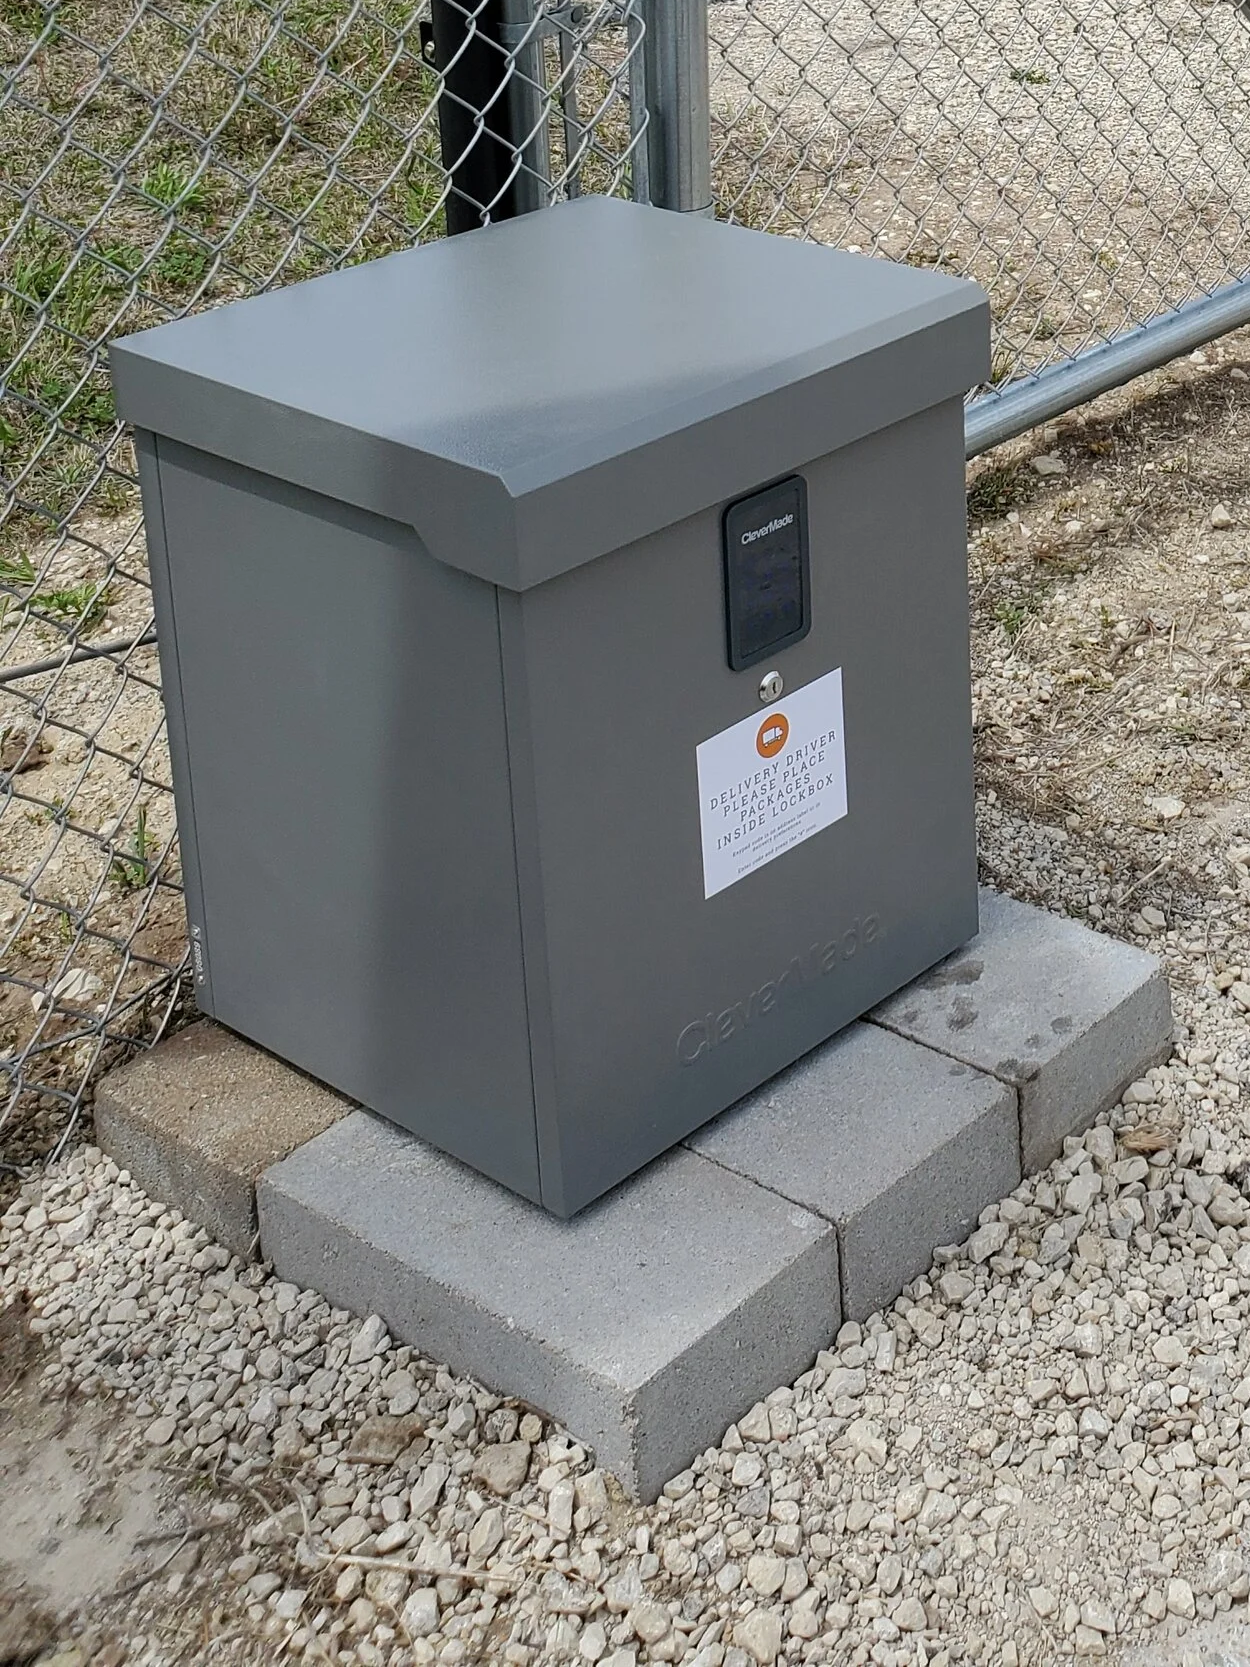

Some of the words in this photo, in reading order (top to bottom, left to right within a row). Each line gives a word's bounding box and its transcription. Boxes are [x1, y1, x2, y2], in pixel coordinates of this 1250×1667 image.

[741, 513, 794, 545] CleverMade
[710, 762, 779, 810] DELIVERY
[786, 730, 836, 767] DRIVER
[723, 778, 776, 818] PLEASE
[783, 750, 825, 782] PLACE
[740, 773, 811, 822] PACKAGES
[717, 813, 766, 850] INSIDE
[772, 773, 834, 818] LOCKBOX
